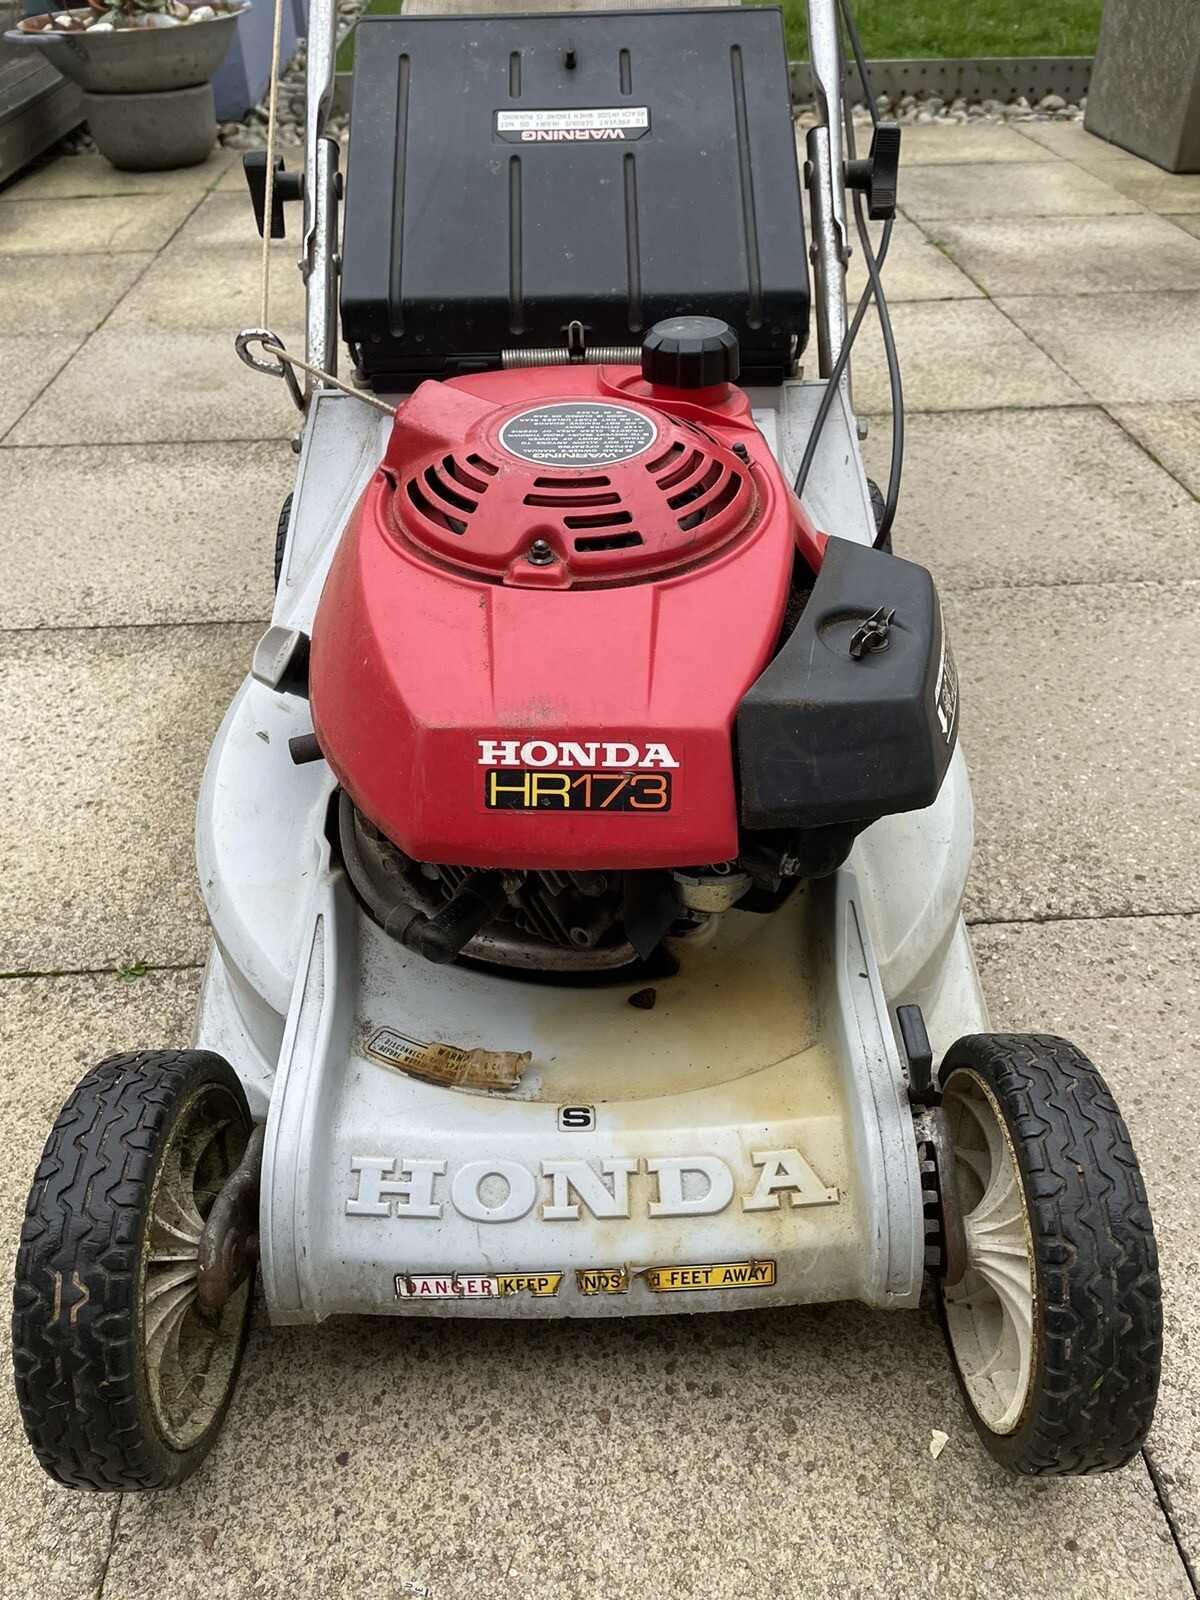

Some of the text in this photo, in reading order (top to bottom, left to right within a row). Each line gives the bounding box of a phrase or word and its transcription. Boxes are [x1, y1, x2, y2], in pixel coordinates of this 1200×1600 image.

[565, 119, 594, 127] SERIOUS
[599, 118, 631, 126] PREVENT
[521, 129, 625, 141] WARNING
[477, 740, 680, 767] HONDA
[490, 772, 667, 808] HR173
[378, 1044, 402, 1059] BEFORE
[384, 1038, 426, 1060] DISCONNECT
[562, 1107, 591, 1127] S
[345, 1149, 839, 1223] HONDA
[405, 1279, 493, 1294] DANGER
[503, 1278, 549, 1292] KEEP
[581, 1274, 621, 1289] NDS
[670, 1270, 712, 1285] FEET
[722, 1267, 770, 1282] AWAY
